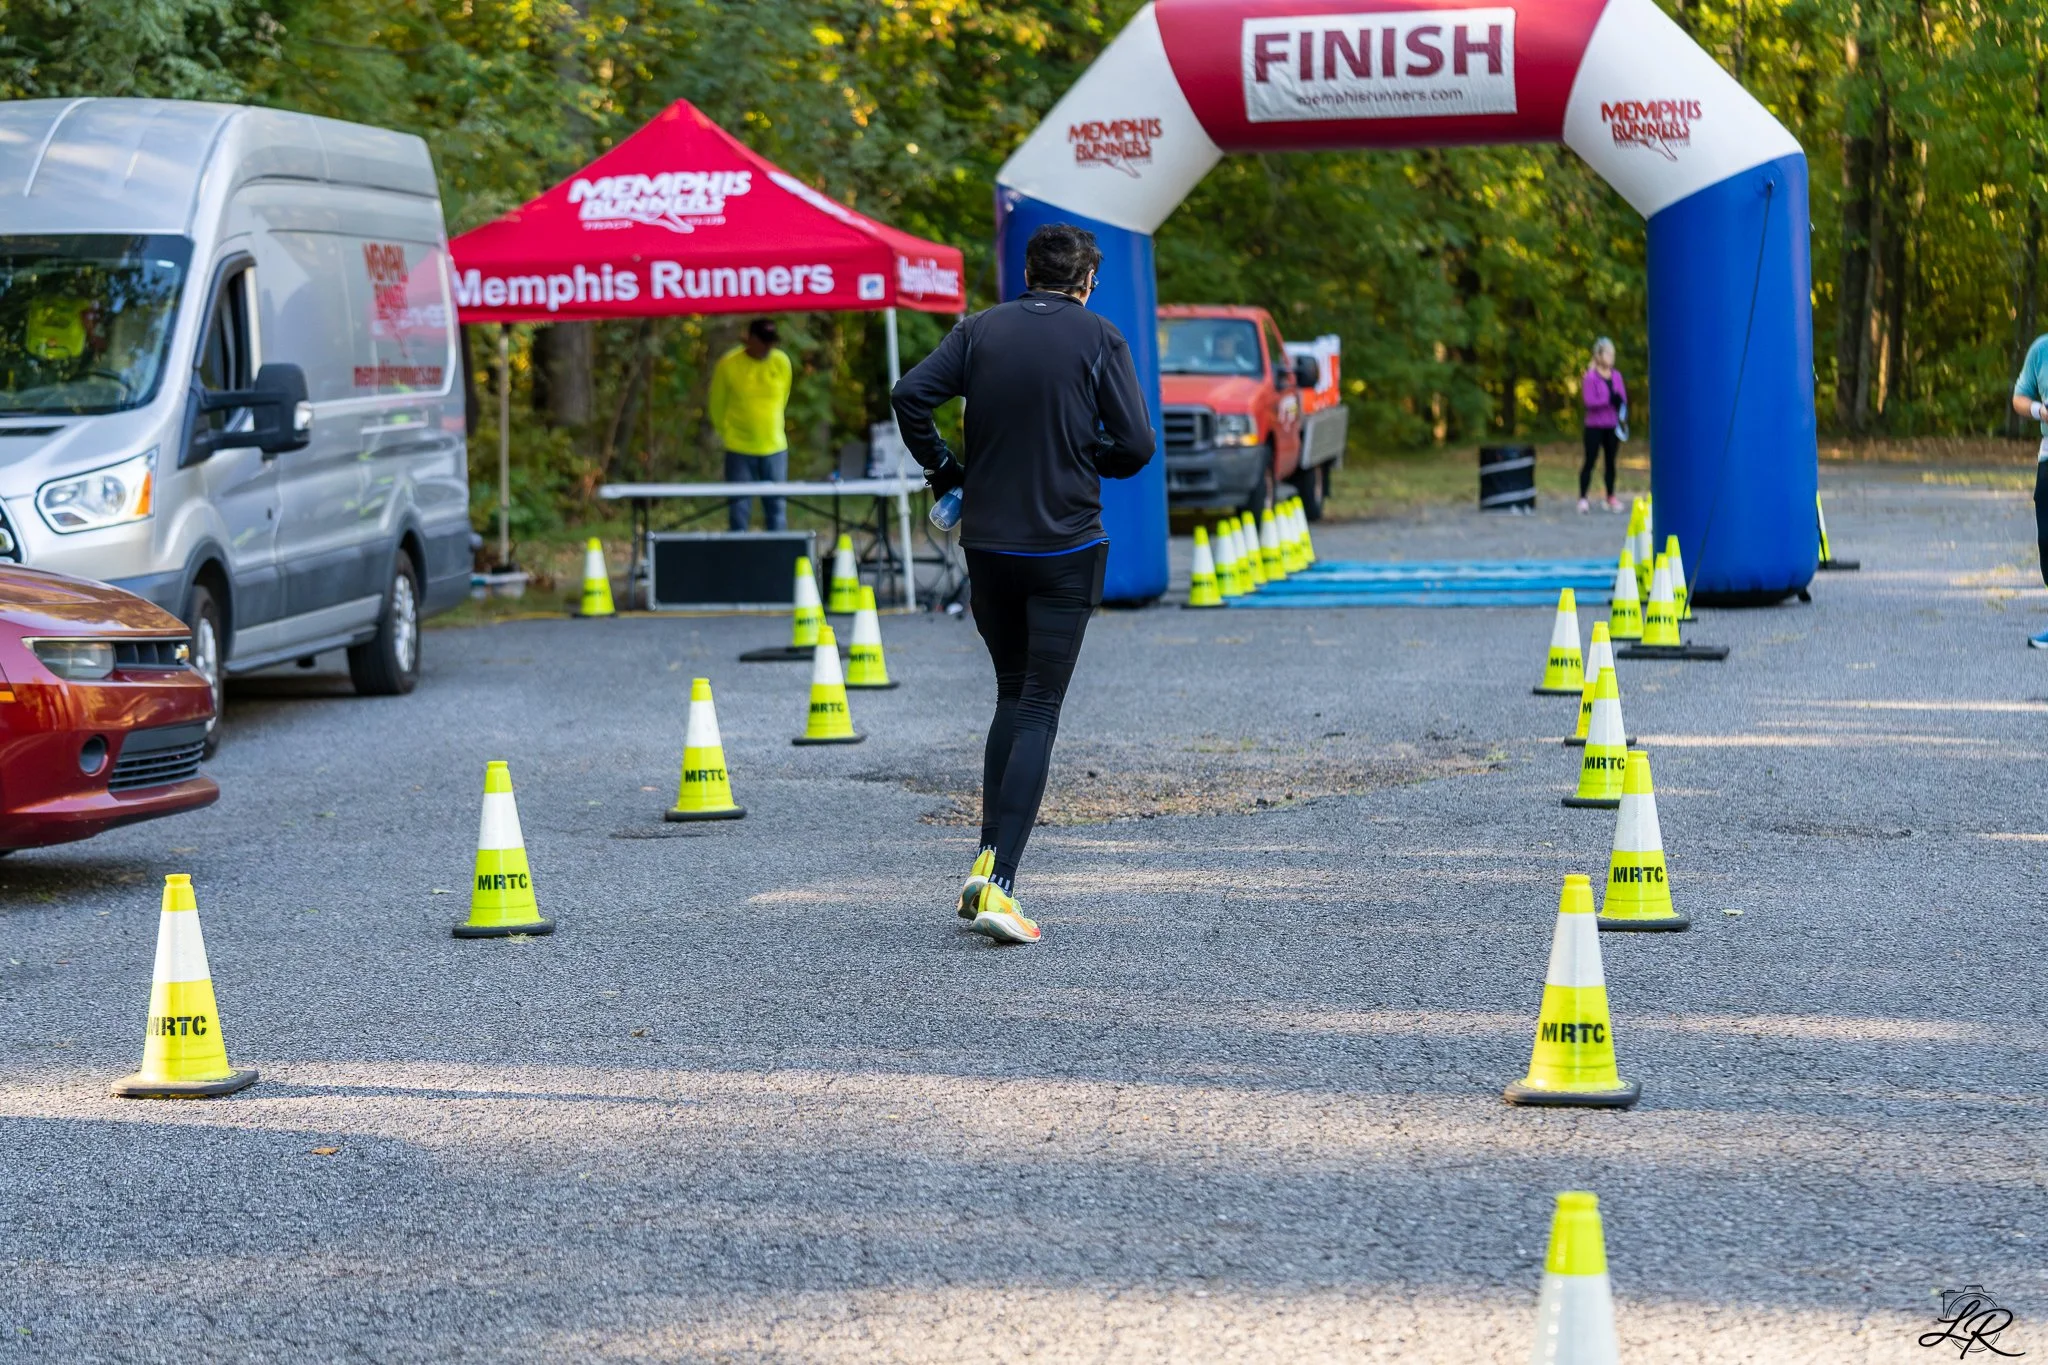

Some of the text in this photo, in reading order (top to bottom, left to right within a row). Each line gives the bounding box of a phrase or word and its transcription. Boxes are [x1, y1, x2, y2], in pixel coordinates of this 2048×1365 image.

[1254, 24, 1503, 84] FINISH
[1600, 99, 1703, 123] MEMPHIS
[1067, 118, 1163, 143] MEMPHIS
[1612, 121, 1690, 141] RUNNERS
[1075, 140, 1152, 162] RUNNERS
[567, 170, 753, 204] MEMPHIS
[578, 195, 726, 221] RUNNERS
[452, 263, 640, 313] Memphis
[649, 260, 836, 301] Runners
[1550, 657, 1582, 668] MRTC
[810, 702, 845, 714] MRTC
[1584, 755, 1626, 771] MRTC
[685, 768, 726, 783] MRTC
[477, 873, 529, 891] MRTC
[1613, 866, 1664, 884] MRTC
[147, 1015, 207, 1037] MRTC
[1541, 1022, 1605, 1044] MRTC
